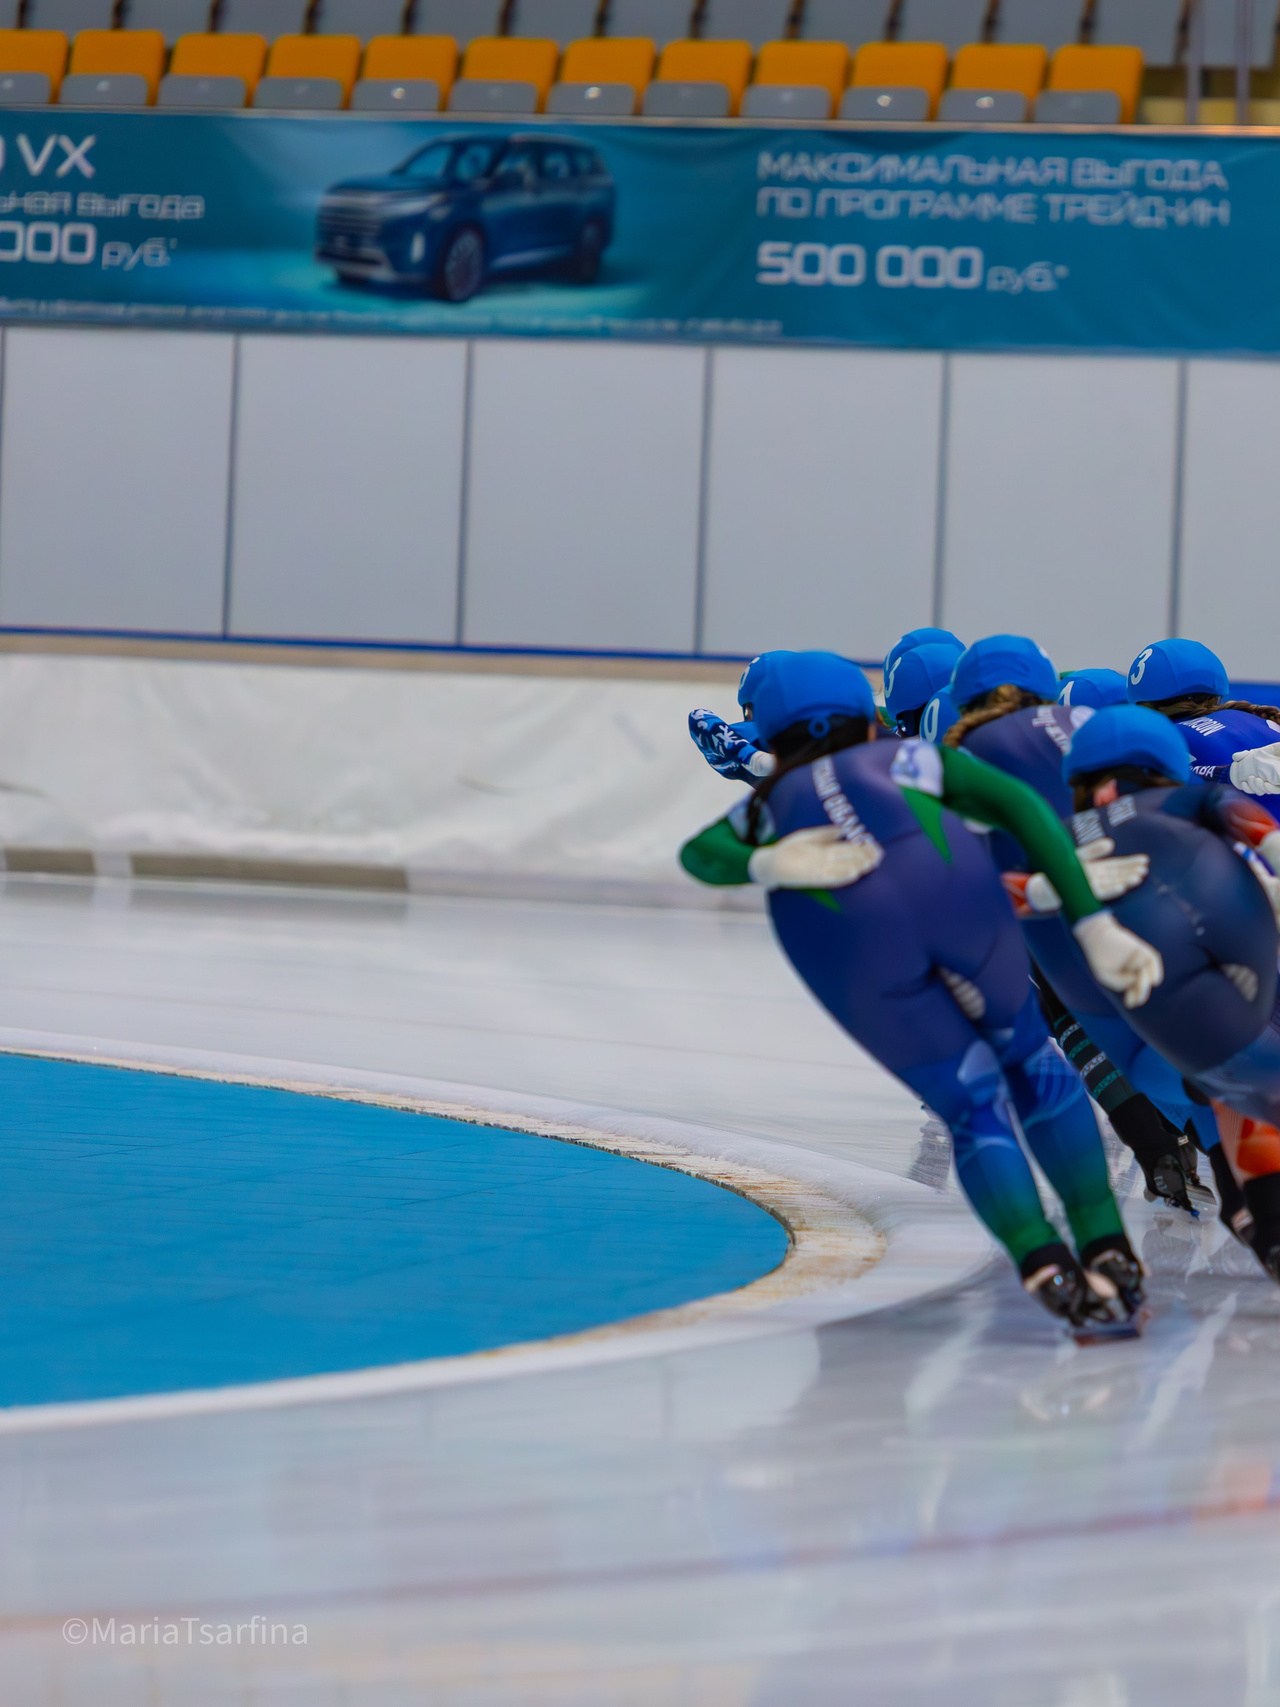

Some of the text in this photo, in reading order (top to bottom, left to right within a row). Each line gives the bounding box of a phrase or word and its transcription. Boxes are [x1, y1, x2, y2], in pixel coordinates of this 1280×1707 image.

[16, 133, 97, 179] VX
[756, 152, 1231, 192] МАКСИМАЛЬНАЯ ВЫГОДА
[756, 186, 812, 218] ПО
[815, 188, 1038, 225] ПРОГРАММЕ
[755, 241, 867, 288] 500
[875, 245, 984, 290] 000
[1131, 648, 1153, 685] 3
